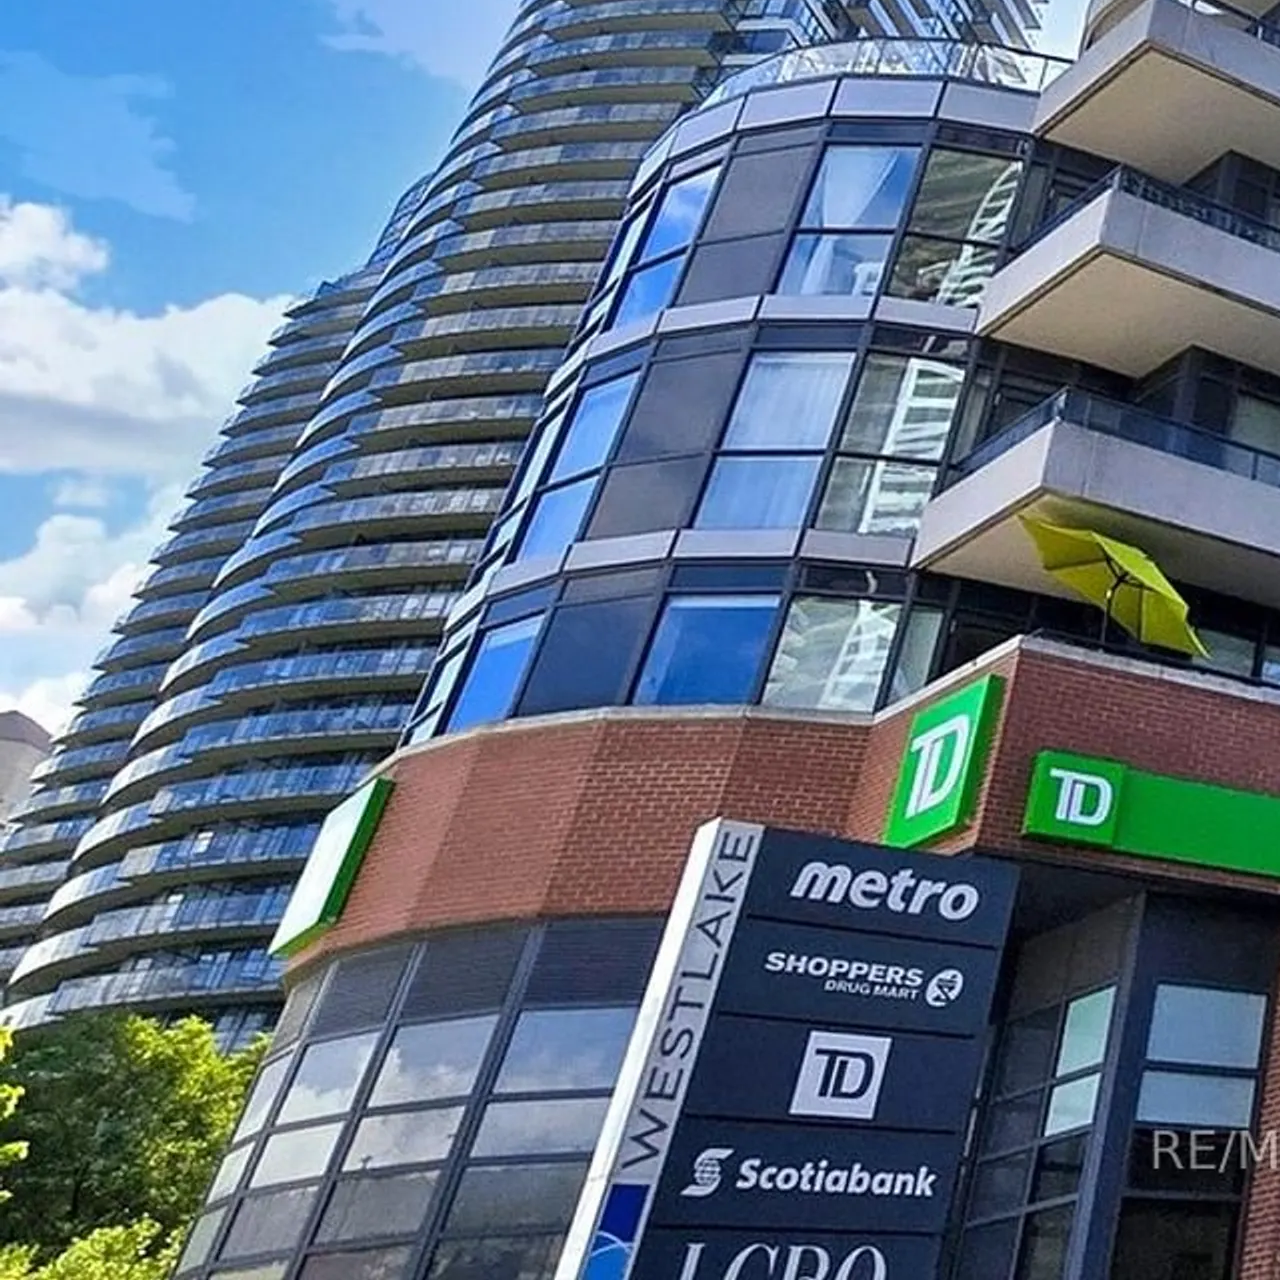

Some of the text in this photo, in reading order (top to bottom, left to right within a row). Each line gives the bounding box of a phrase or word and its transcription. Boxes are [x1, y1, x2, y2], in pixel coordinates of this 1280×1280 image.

[905, 713, 970, 819] TD
[1050, 768, 1112, 826] TD
[790, 861, 979, 920] metro
[764, 951, 924, 987] SHOPPERS
[824, 979, 920, 1000] DRUG MART
[621, 831, 754, 1168] WESTLAKE
[815, 1048, 875, 1100] TD
[736, 1158, 937, 1197] Scotiabank
